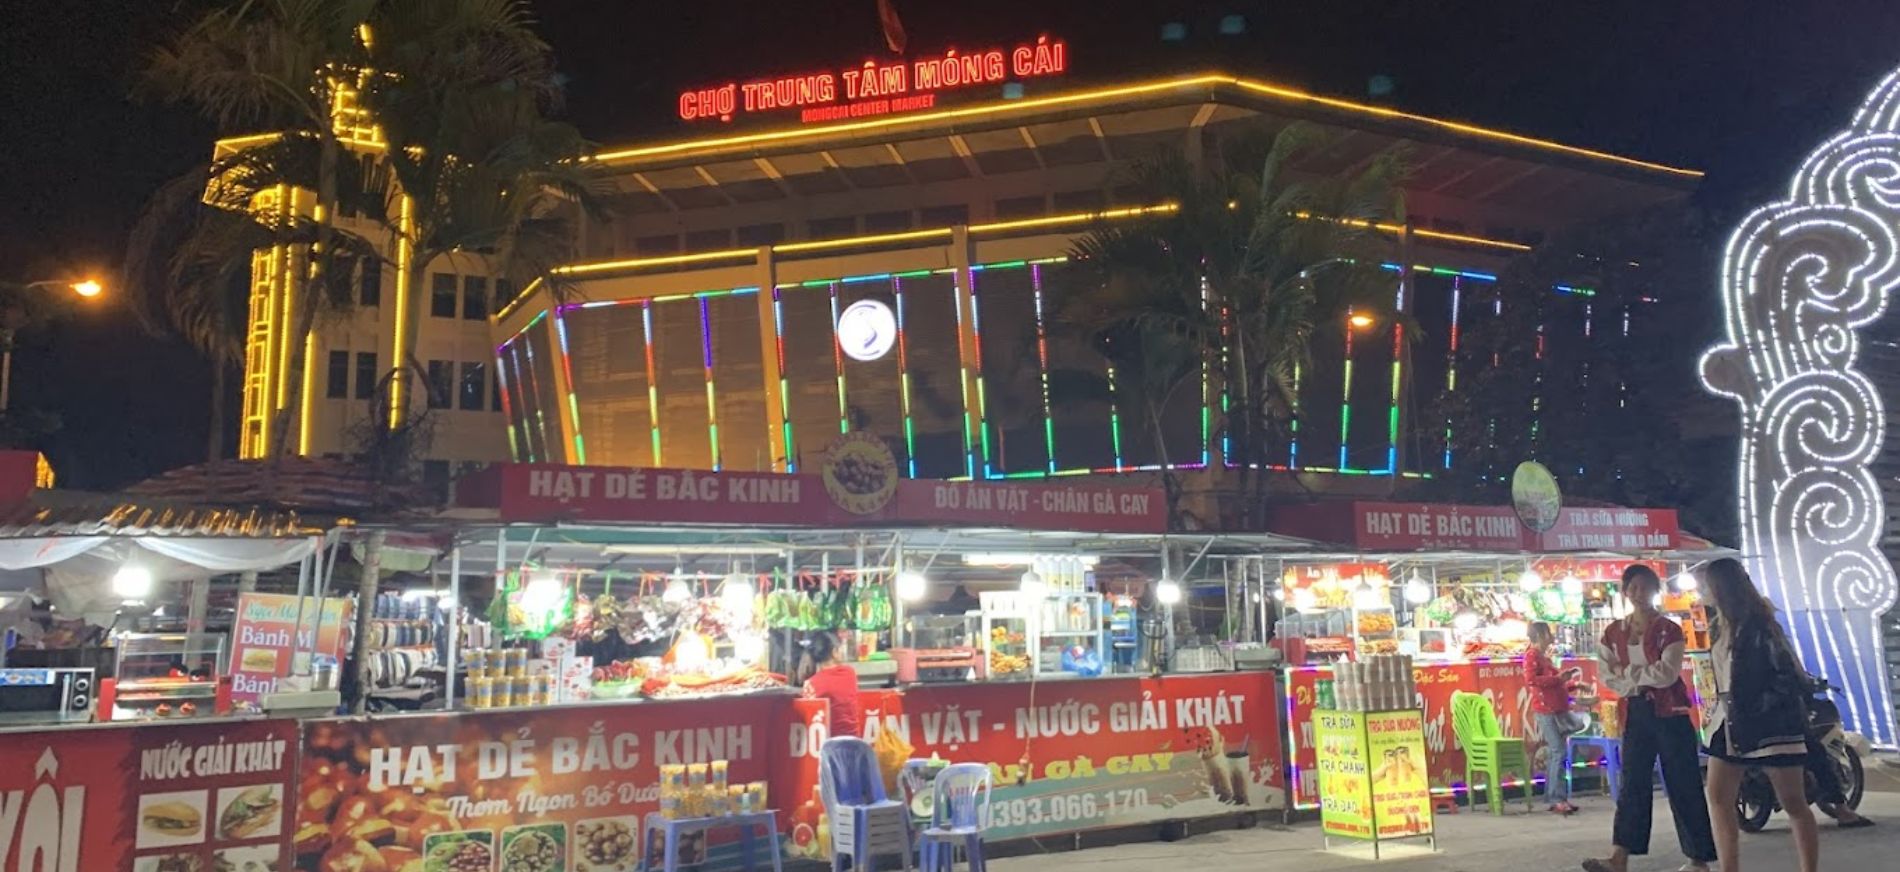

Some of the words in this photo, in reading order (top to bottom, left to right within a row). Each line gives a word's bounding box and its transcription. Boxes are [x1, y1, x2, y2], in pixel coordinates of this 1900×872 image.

[679, 84, 736, 121] CHỢ
[742, 74, 834, 112] TRUNG
[842, 61, 907, 99] TÂM
[914, 50, 1004, 90] MÓNG
[1013, 36, 1063, 76] CÁI
[850, 100, 890, 117] CENTER
[892, 94, 935, 112] MARKET
[529, 470, 594, 503] HẠT
[656, 468, 720, 500] BẮC
[728, 477, 800, 503] KINH
[1042, 487, 1089, 513] CHÂN
[1093, 489, 1116, 515] GÀ
[1120, 493, 1149, 515] CAY
[1366, 511, 1401, 539] HẠT
[1408, 506, 1432, 536] DẺ
[1437, 507, 1472, 537] BẮC
[1475, 516, 1517, 538] KINH
[240, 625, 291, 647] Bánh
[920, 704, 982, 751] VẶT
[1016, 699, 1100, 739] NƯỚC
[1110, 690, 1168, 733] GIẢI
[1176, 690, 1245, 729] KHÁT
[140, 739, 192, 780] NƯỚC
[194, 735, 234, 776] GIẢI
[235, 732, 286, 773] KHÁT
[368, 744, 463, 793] HẠT
[479, 727, 536, 780] DẺ
[552, 720, 640, 774] BẮC
[654, 724, 752, 767] KINH
[1044, 755, 1096, 780] GÀ
[447, 796, 512, 818] Thơm
[517, 789, 577, 816] Ngon
